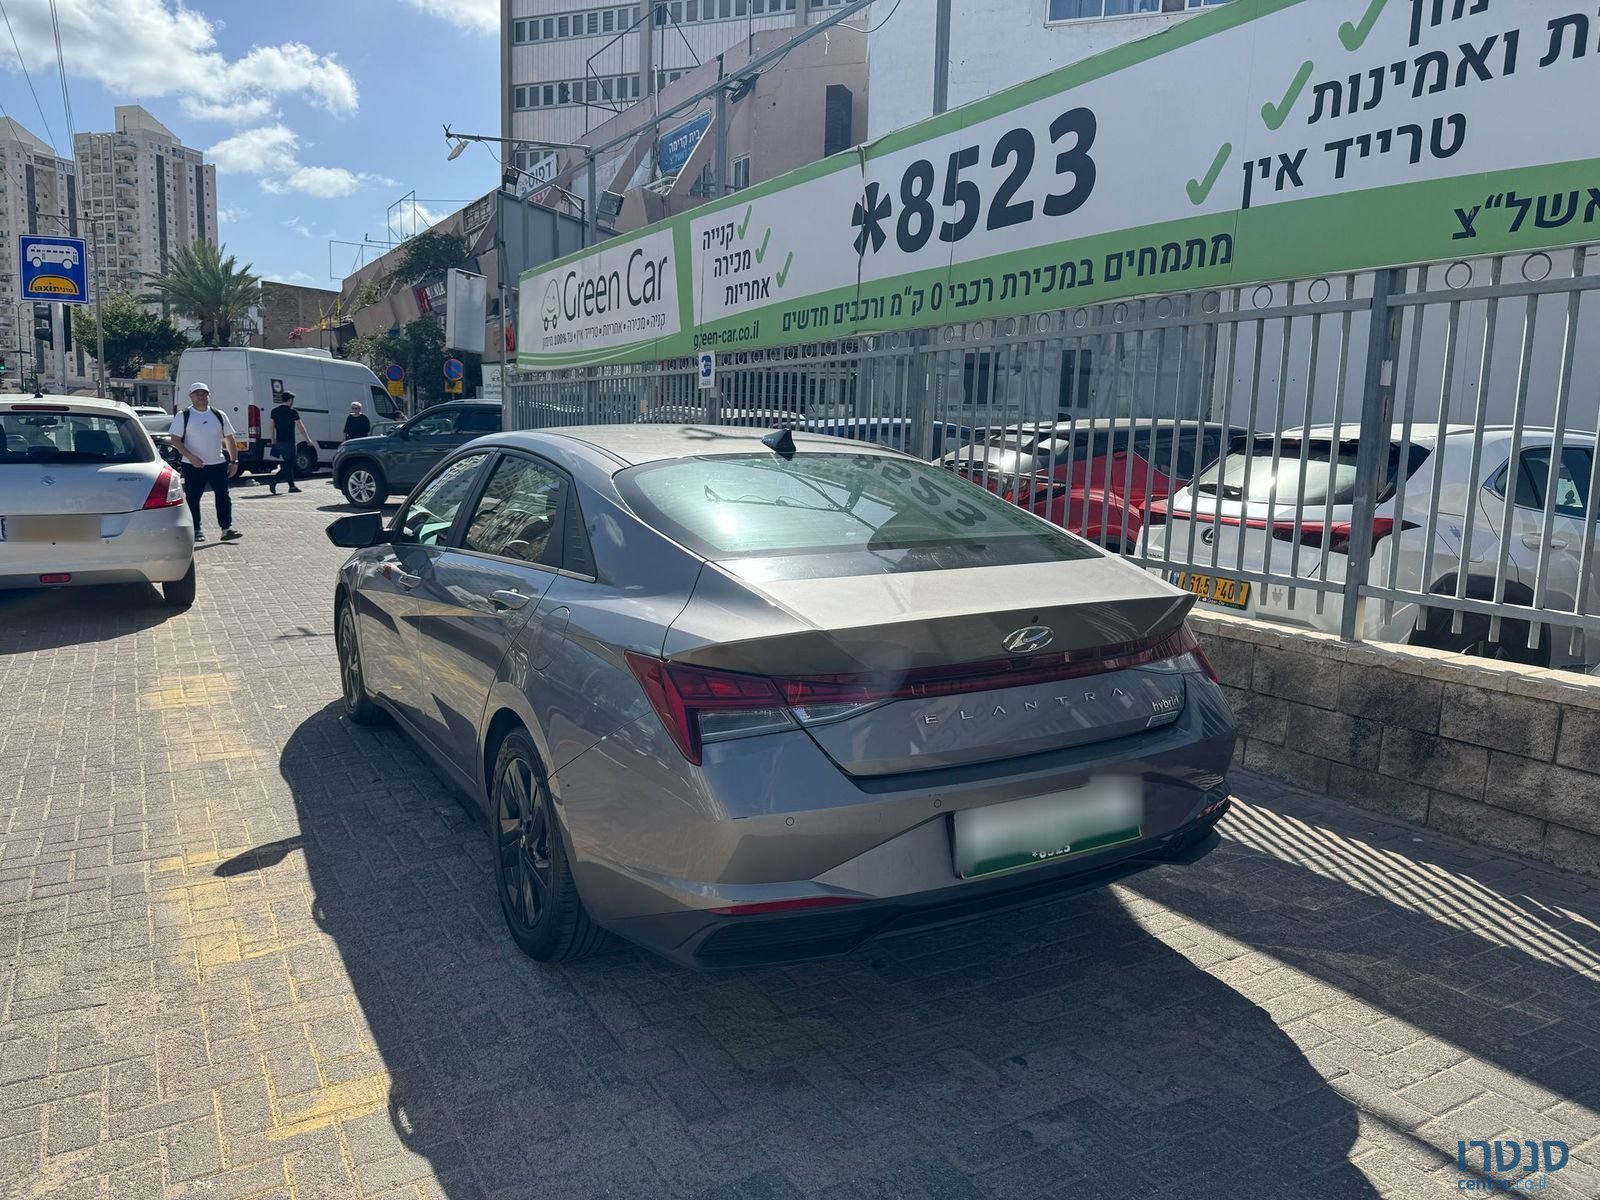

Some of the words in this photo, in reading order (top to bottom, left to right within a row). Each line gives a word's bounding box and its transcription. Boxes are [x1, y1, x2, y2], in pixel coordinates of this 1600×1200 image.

[1308, 29, 1520, 124] ואמינות
[1324, 113, 1466, 179] טרייד
[1242, 148, 1308, 209] אין
[702, 222, 734, 250] קנייה
[714, 249, 751, 278] מכירה
[1103, 233, 1233, 282] מתמחים
[563, 270, 621, 321] Green
[626, 248, 668, 307] Car
[724, 276, 771, 307] אחריות
[949, 278, 994, 304] רכבי
[999, 258, 1094, 300] במכירת
[833, 296, 884, 325] ורכבים
[930, 282, 943, 311] 0
[693, 320, 760, 348] green-car.co.il
[782, 306, 829, 332] חדשים
[924, 687, 1127, 725] ELANTRA
[1152, 695, 1179, 713] hybrid
